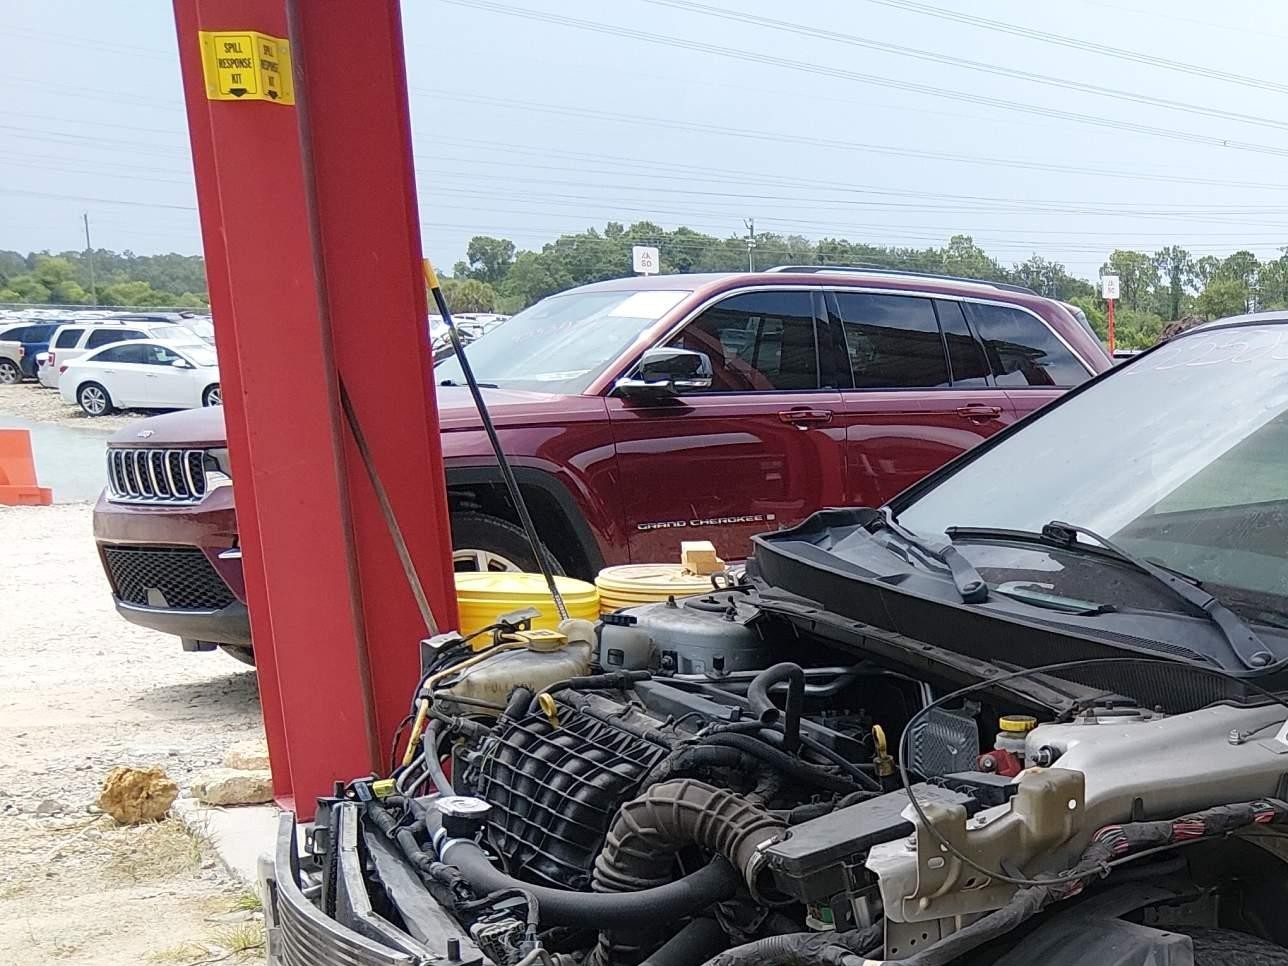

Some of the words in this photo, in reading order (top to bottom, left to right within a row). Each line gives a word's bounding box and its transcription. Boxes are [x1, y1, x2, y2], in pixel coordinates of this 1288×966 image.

[224, 42, 243, 54] SPILL
[218, 58, 253, 69] RESPONSE
[231, 73, 242, 84] KIT
[637, 520, 686, 530] GRAND
[690, 514, 763, 526] CHEROKEE
